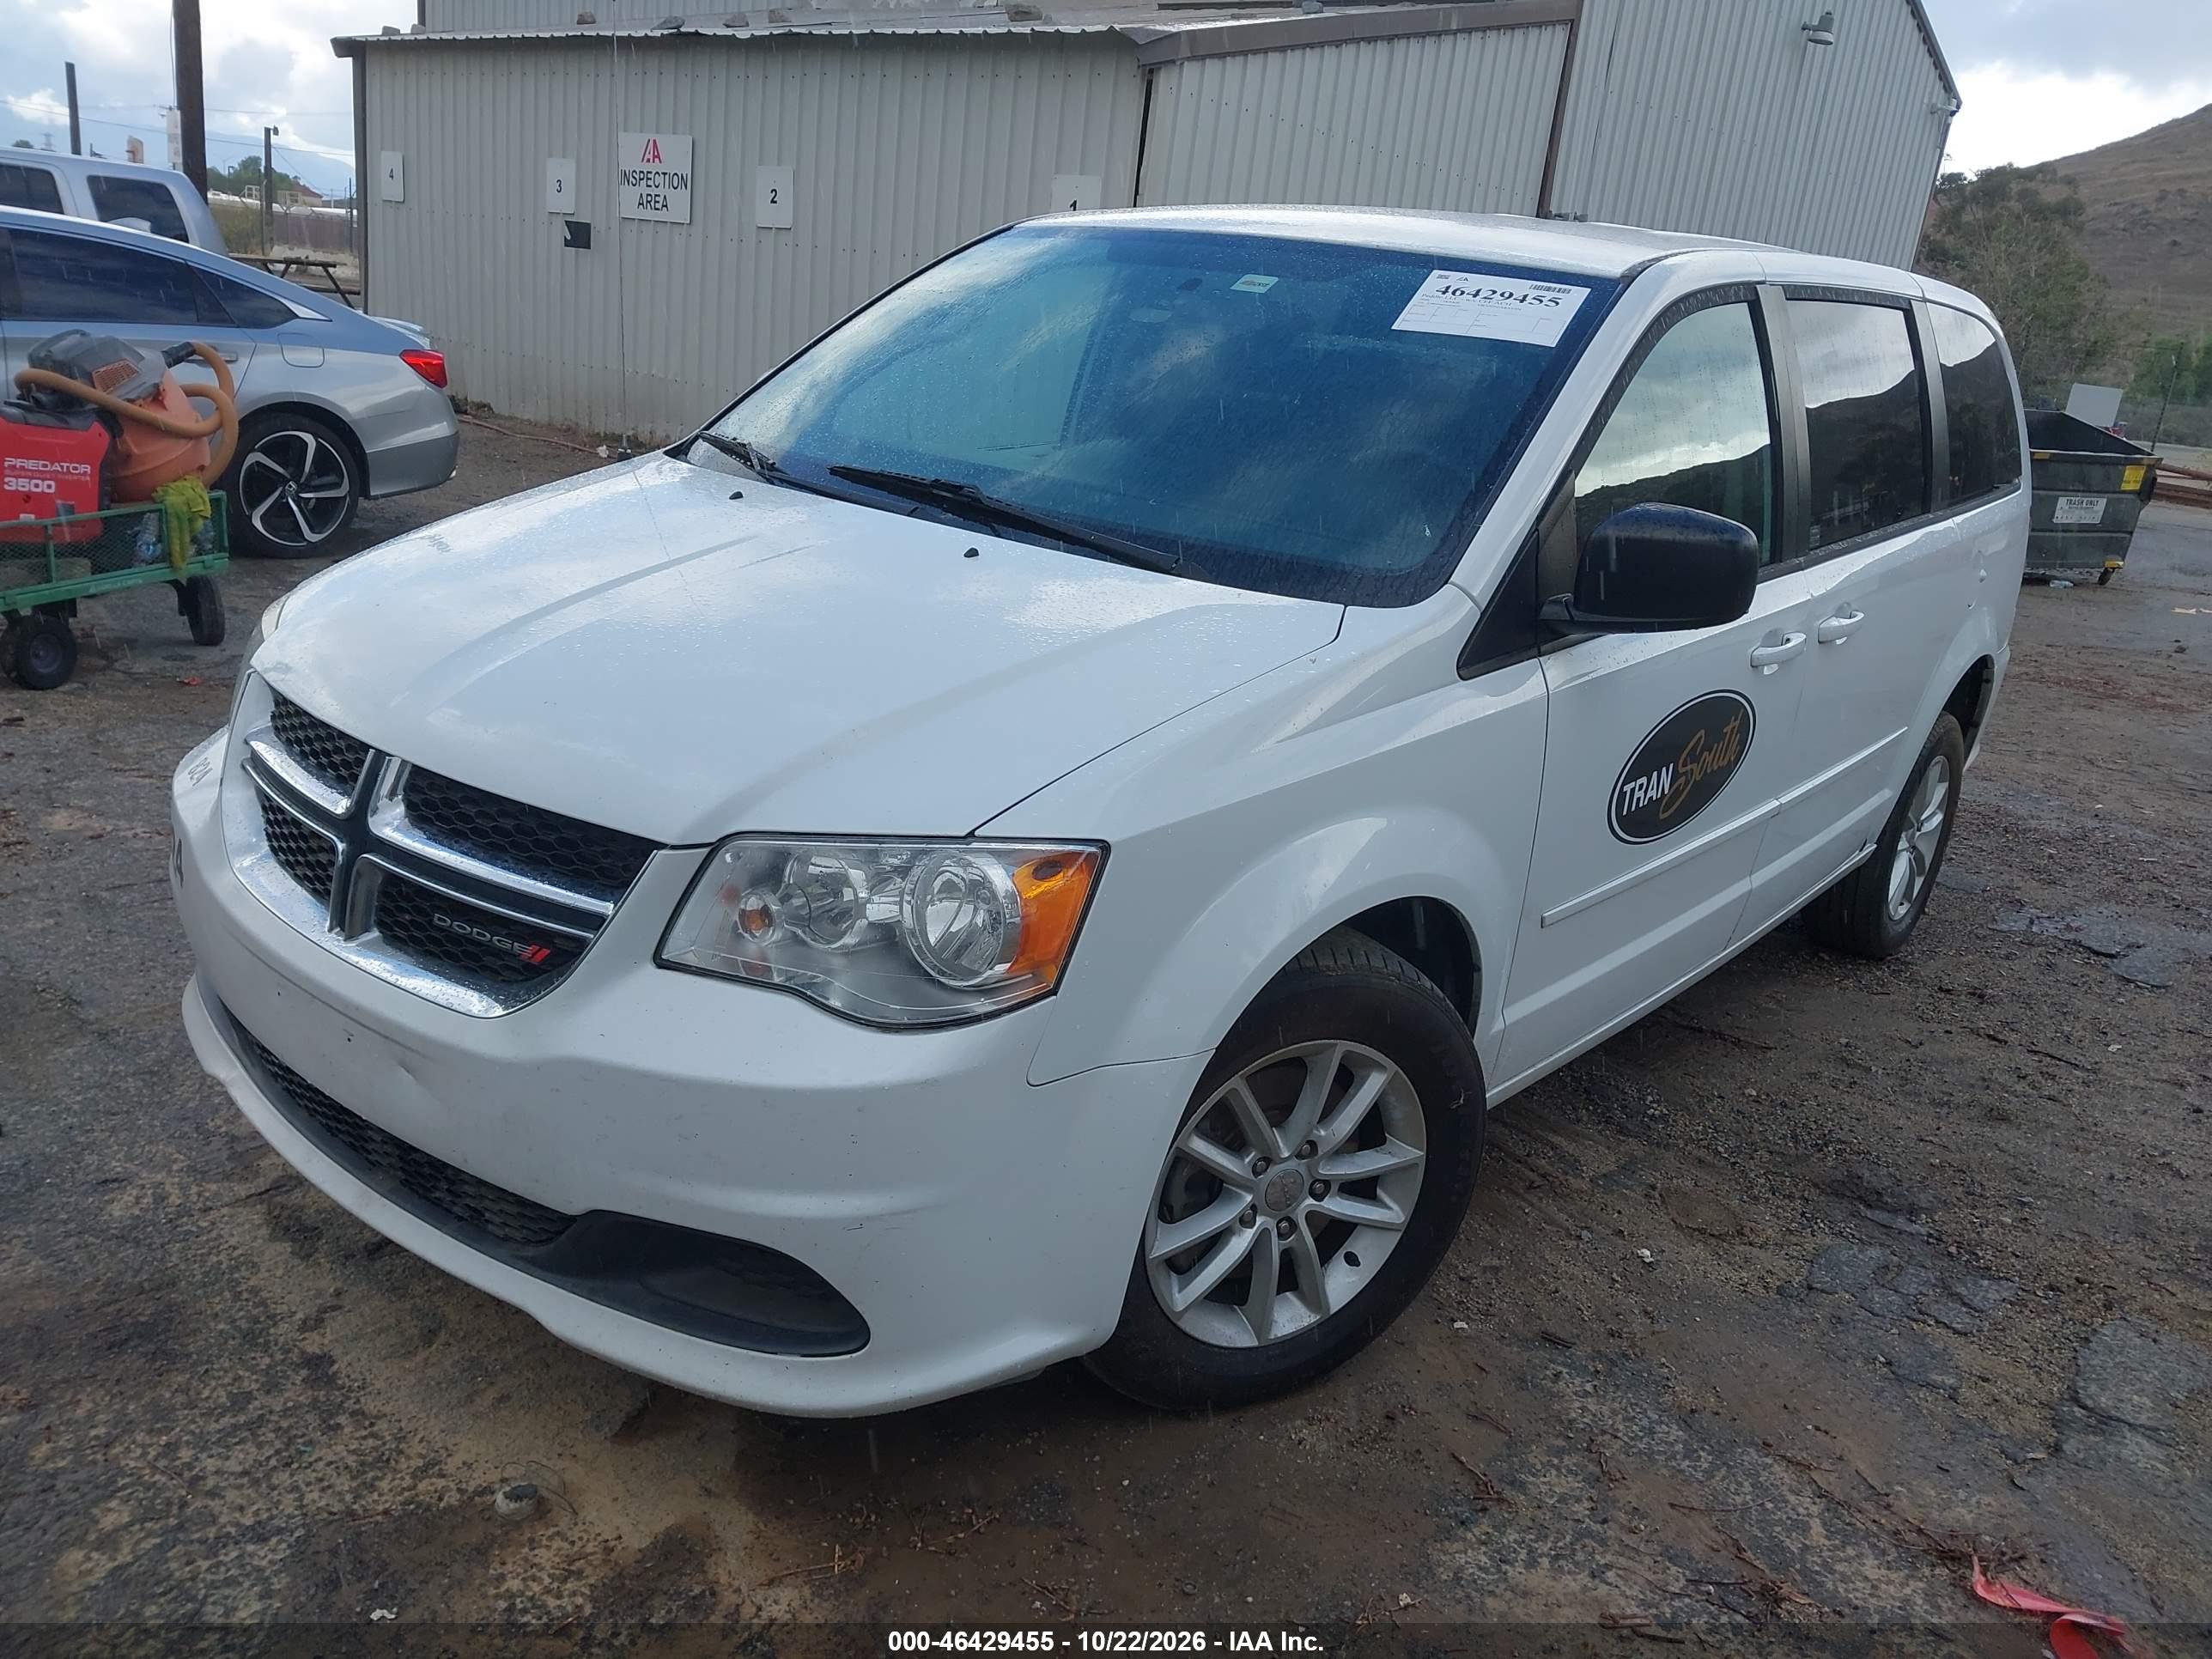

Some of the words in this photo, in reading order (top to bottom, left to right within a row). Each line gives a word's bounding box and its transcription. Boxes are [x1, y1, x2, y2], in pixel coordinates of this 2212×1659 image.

[388, 167, 394, 181] 4
[620, 169, 689, 191] INSPECTION
[556, 179, 562, 193] 3
[637, 192, 669, 212] AREA
[769, 188, 778, 204] 2
[1069, 199, 1078, 211] 1
[1435, 284, 1563, 307] 46429455
[3, 457, 91, 475] PREDATOR
[3, 477, 56, 494] 3500
[1622, 763, 1674, 817] TRAN
[1659, 708, 1745, 820] South
[433, 913, 533, 959] DODGE
